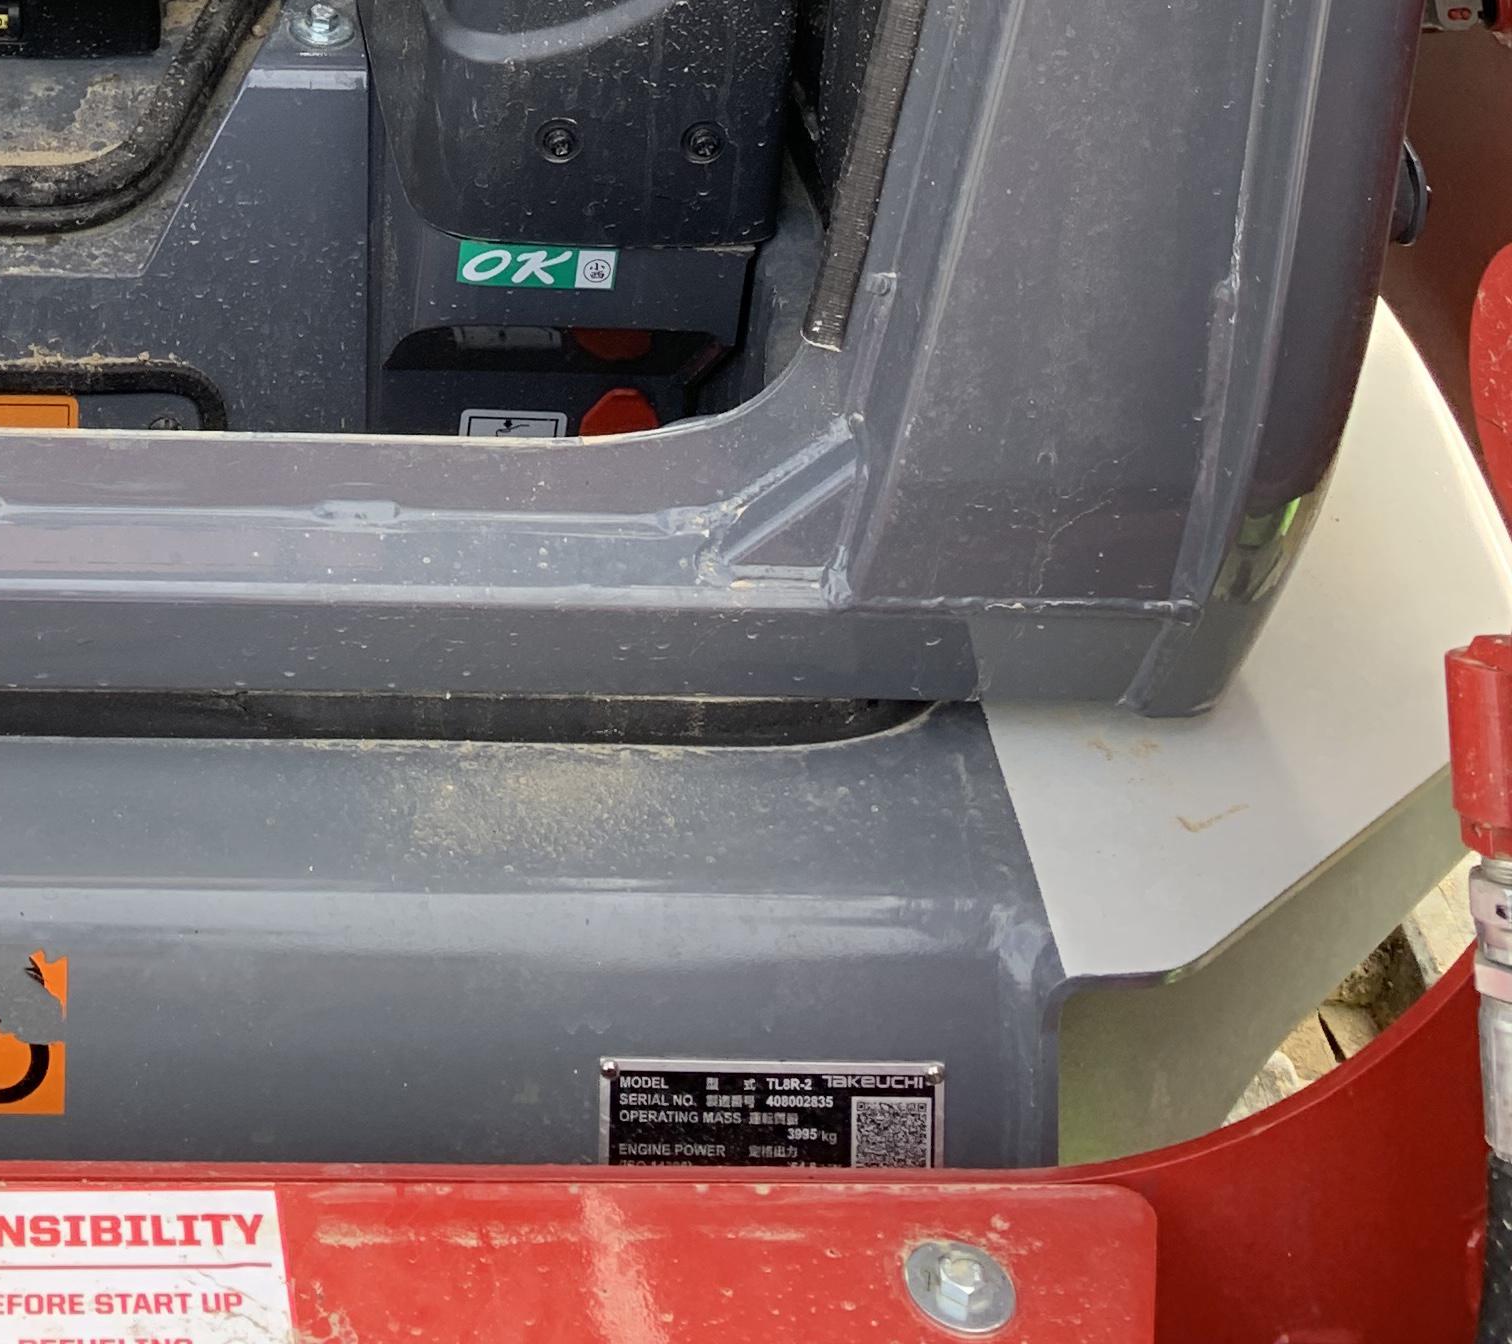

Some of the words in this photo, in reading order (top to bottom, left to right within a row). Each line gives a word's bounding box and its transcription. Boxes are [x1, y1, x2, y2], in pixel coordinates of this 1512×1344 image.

[462, 249, 573, 285] OK
[619, 1076, 669, 1089] MODEL
[766, 1078, 812, 1091] TL8R-2
[619, 1093, 669, 1106] SERIAL
[672, 1094, 697, 1106] NO.
[619, 1110, 698, 1123] OPERATING
[702, 1112, 742, 1124] MASS
[787, 1128, 818, 1140] 3995
[821, 1130, 838, 1145] kg
[618, 1144, 671, 1156] ENGINE
[674, 1144, 726, 1157] POWER
[95, 1292, 193, 1315] START
[201, 1292, 243, 1313] UP
